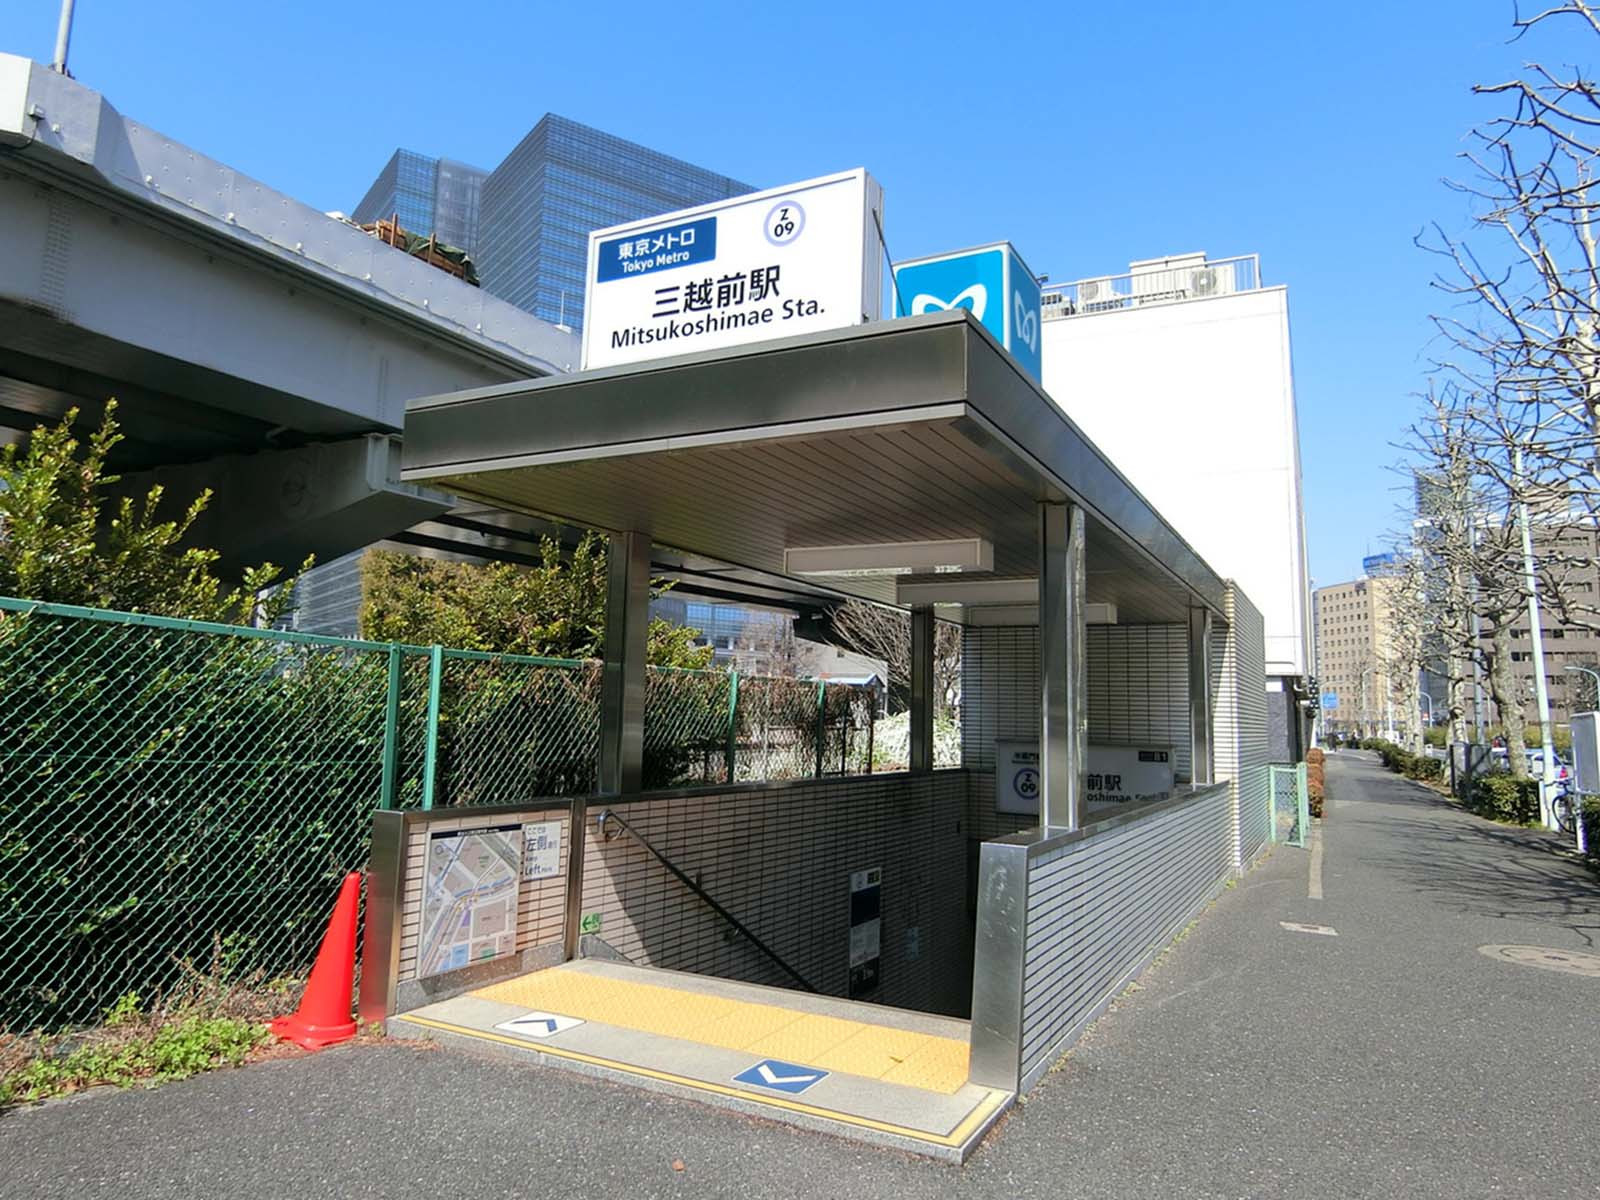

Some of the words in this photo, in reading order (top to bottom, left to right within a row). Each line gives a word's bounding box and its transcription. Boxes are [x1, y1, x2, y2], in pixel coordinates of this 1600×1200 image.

[781, 208, 789, 221] Z
[773, 221, 795, 237] 09
[617, 228, 696, 260] 東京メトロ
[622, 259, 654, 273] Tokyo
[656, 251, 690, 266] Metro
[652, 265, 781, 318] 三越前駅
[611, 306, 774, 349] Mitsukoshimae
[782, 298, 826, 320] Sta.
[1023, 773, 1033, 782] Z
[1087, 773, 1122, 791] 前駅
[1020, 782, 1037, 793] 09
[1086, 792, 1132, 803] oshimae
